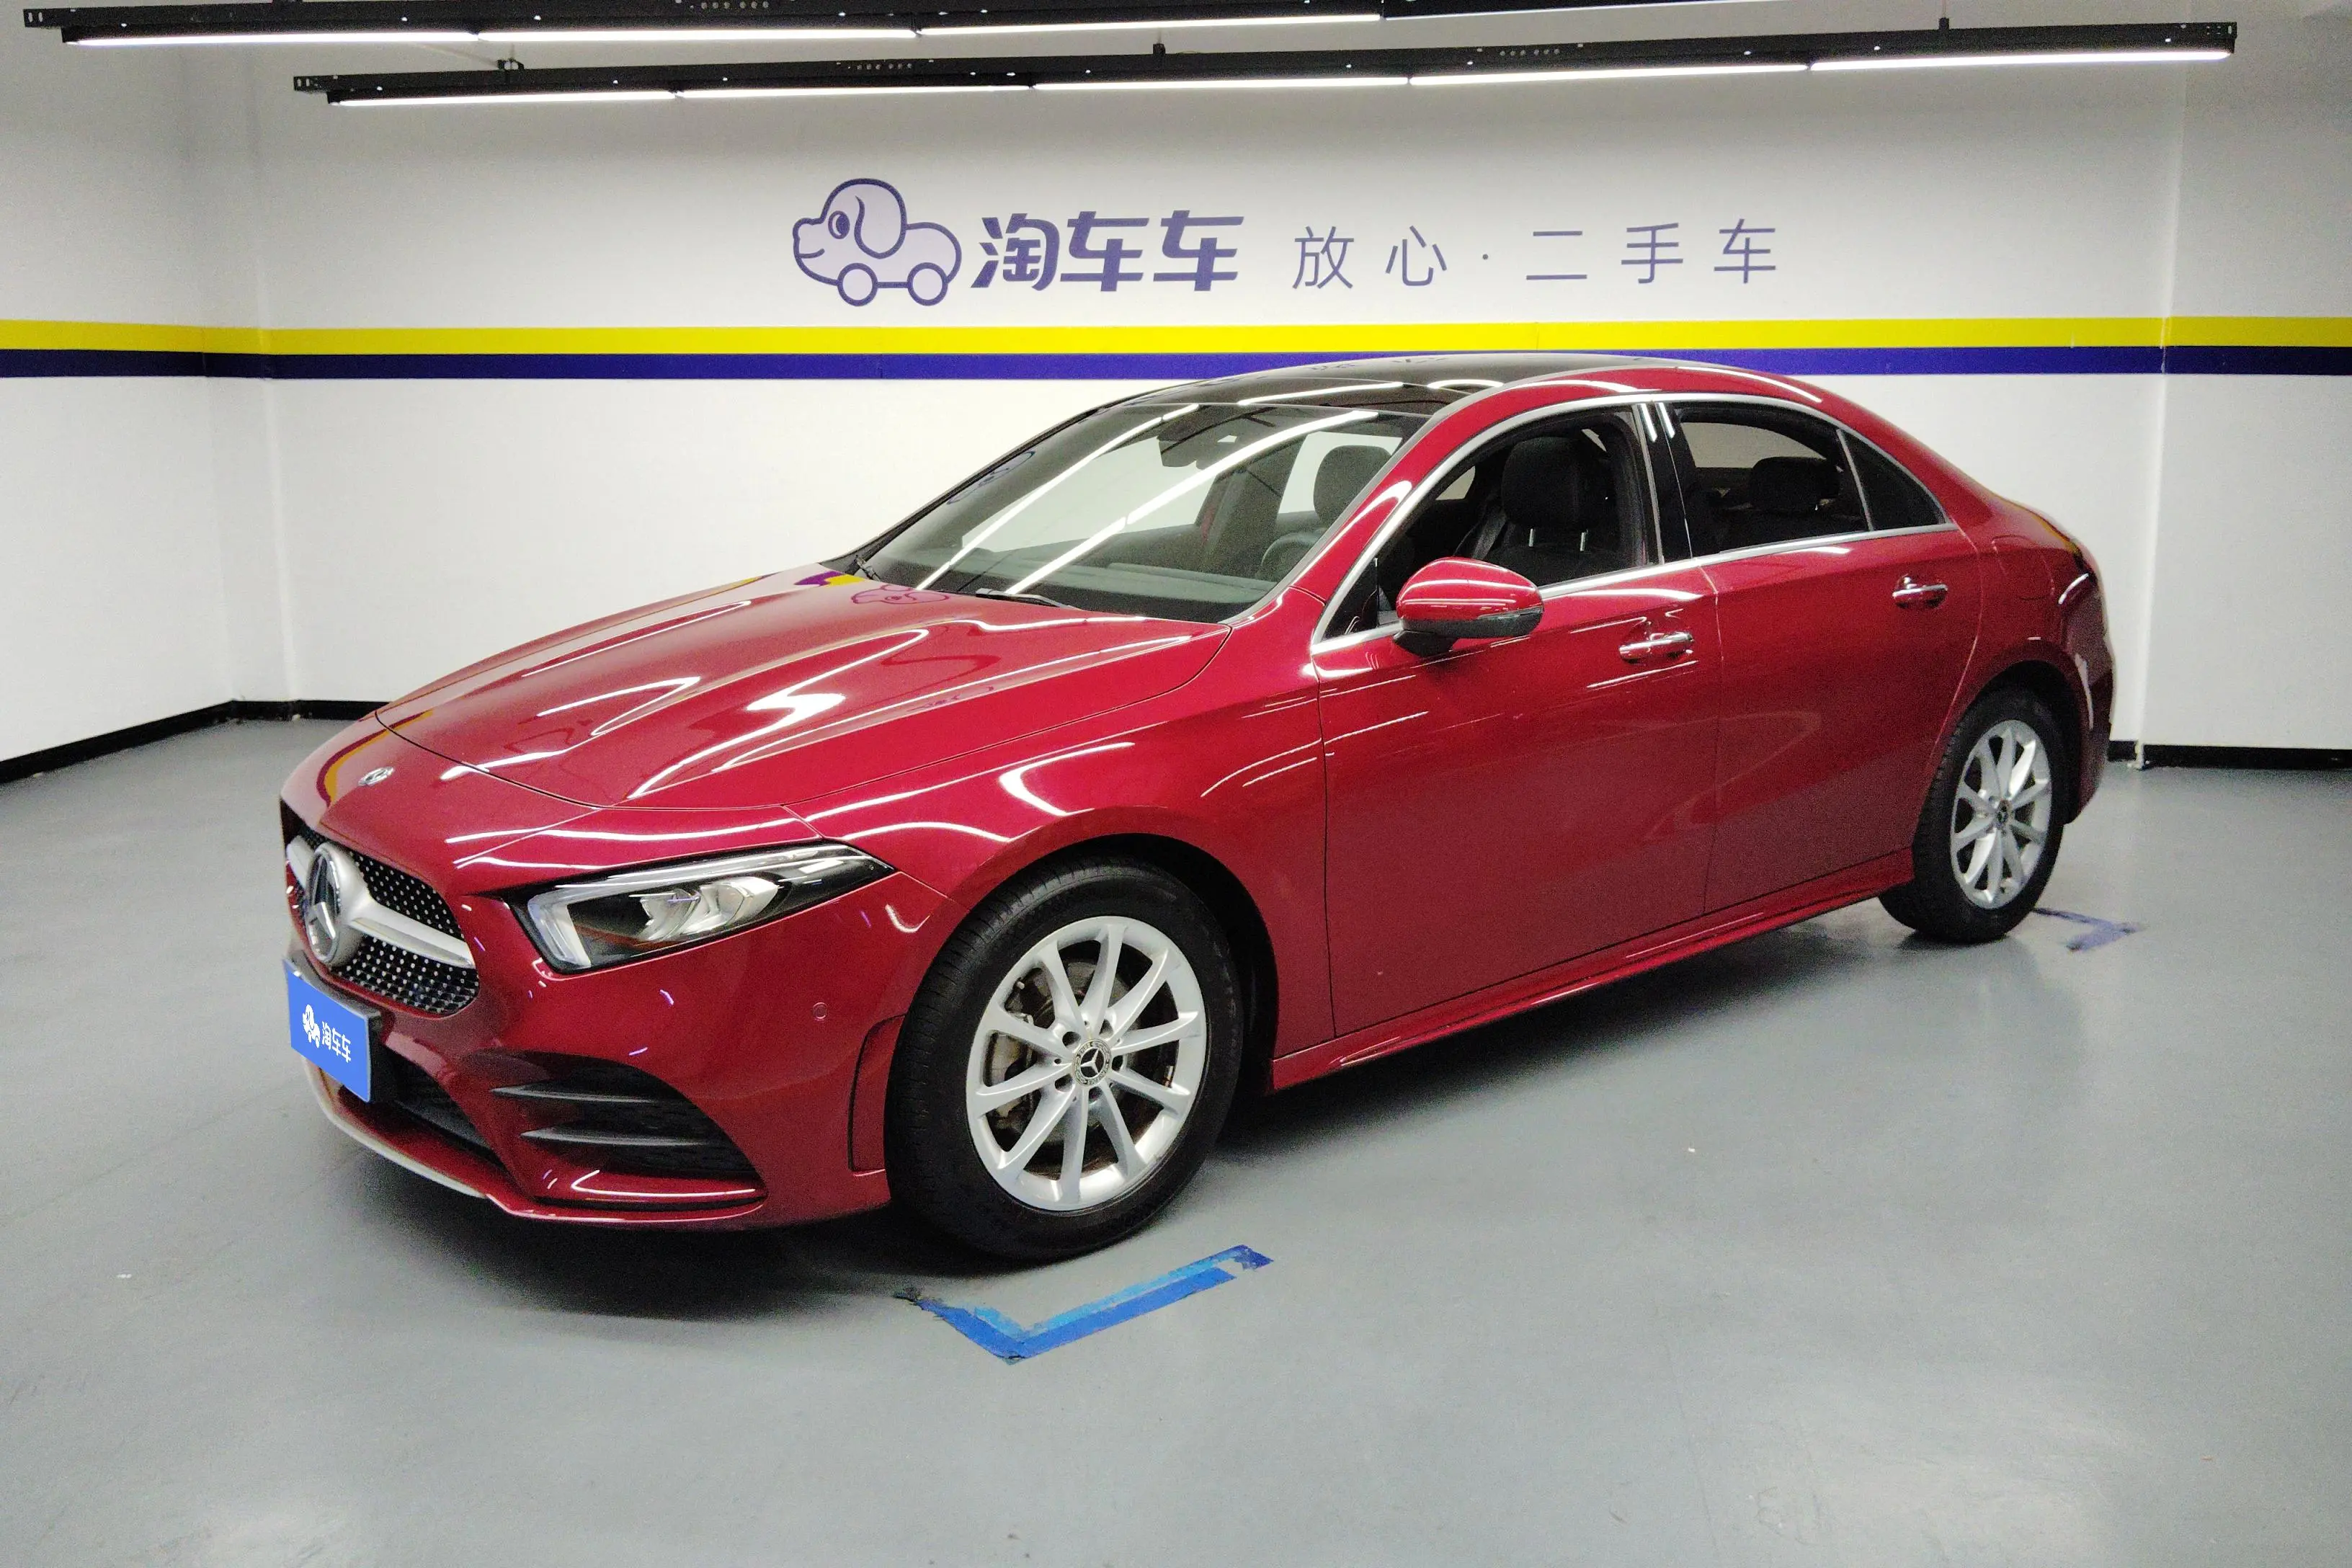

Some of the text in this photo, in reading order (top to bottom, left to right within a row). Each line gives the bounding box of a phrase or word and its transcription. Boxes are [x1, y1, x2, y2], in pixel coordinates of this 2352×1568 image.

[971, 210, 1244, 292] 淘车车
[321, 1021, 352, 1063] 淘车车
